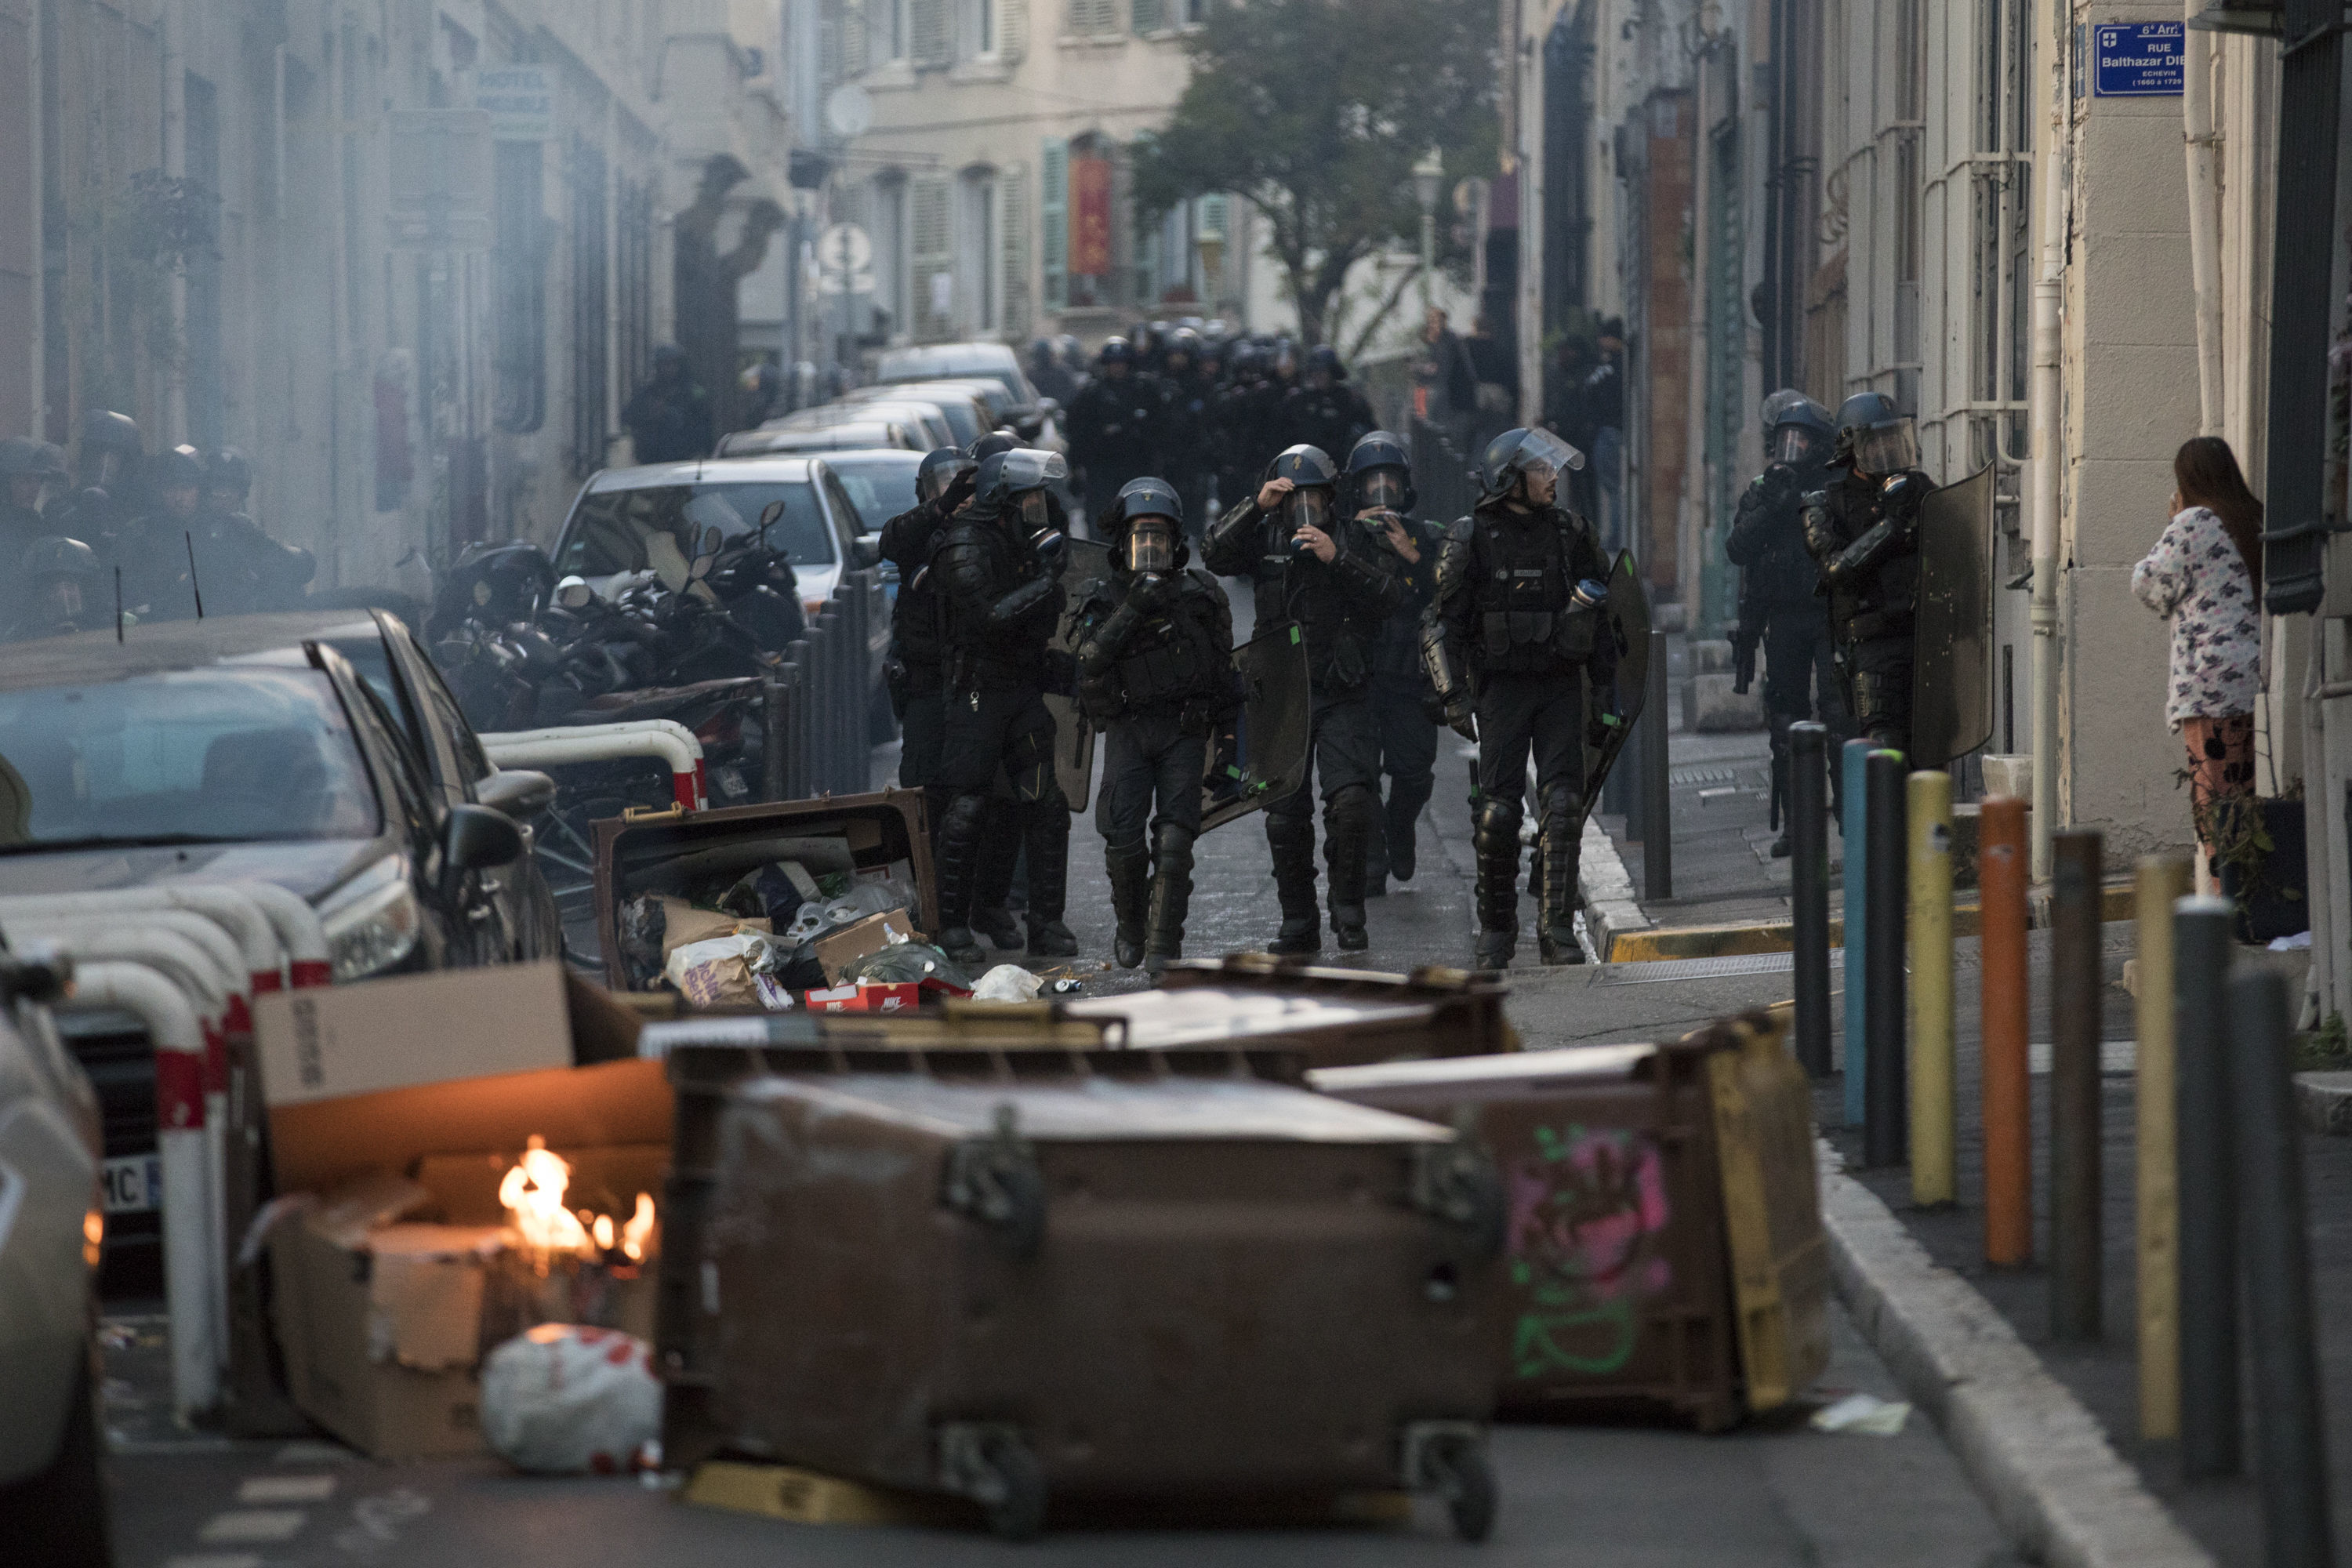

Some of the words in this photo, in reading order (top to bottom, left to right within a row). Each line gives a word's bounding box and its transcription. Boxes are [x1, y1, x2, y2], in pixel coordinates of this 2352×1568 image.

[2147, 43, 2172, 53] RUE
[2102, 56, 2162, 67] Balthazar
[826, 1001, 843, 1012] NIKE
[883, 996, 902, 1010] NIKE
